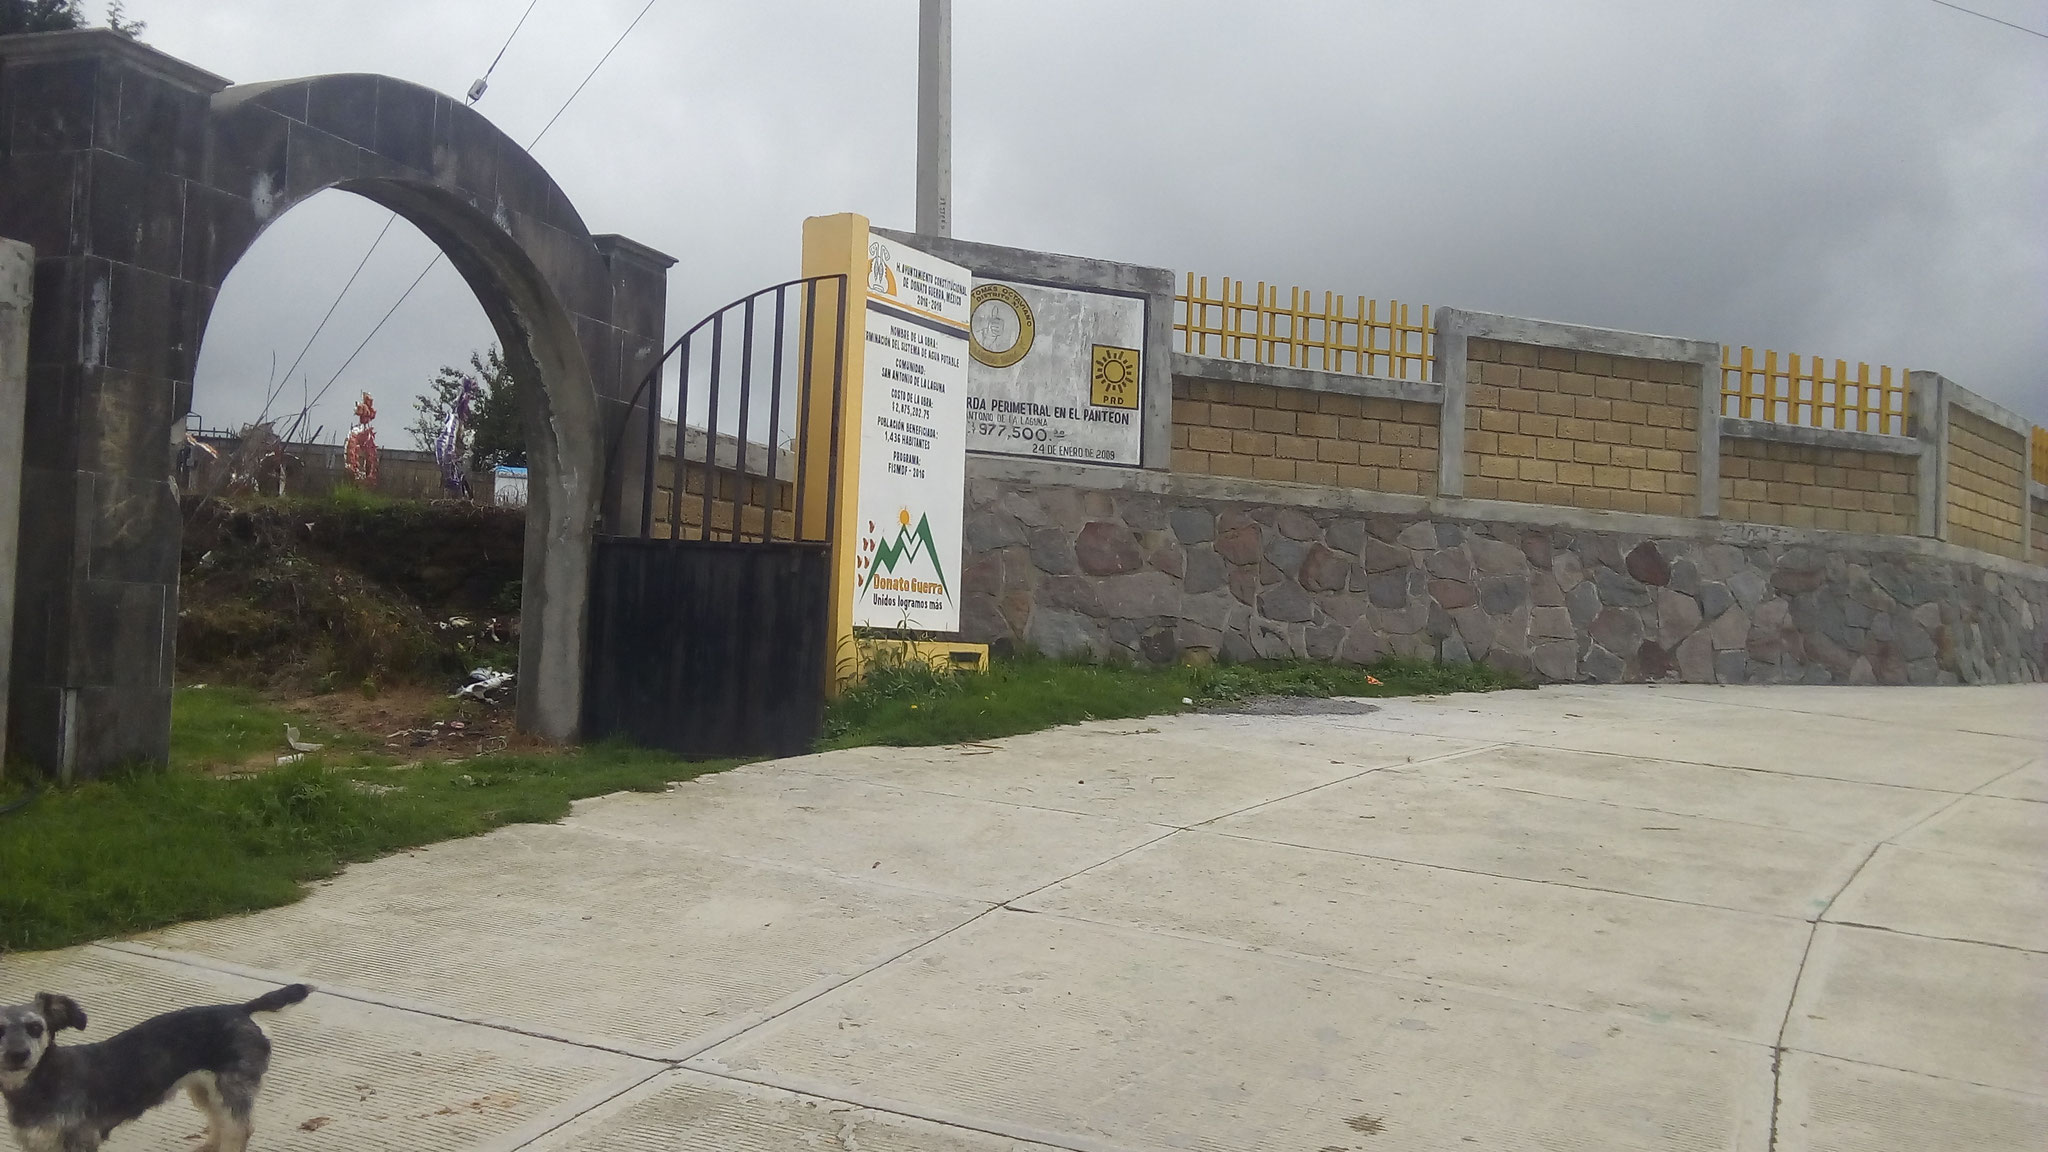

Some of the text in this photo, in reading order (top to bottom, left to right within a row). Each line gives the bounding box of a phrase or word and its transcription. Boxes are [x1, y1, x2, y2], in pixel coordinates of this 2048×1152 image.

[902, 263, 933, 284] AYUNTAMIENTO
[934, 275, 967, 296] CONSTITUCIONAL
[902, 276, 909, 289] DE
[910, 279, 928, 295] DONATO
[976, 292, 1009, 303] DISTRITO
[1002, 288, 1032, 327] OCTAVIANO
[890, 325, 910, 341] NOMBRE
[910, 331, 917, 343] DE
[917, 333, 924, 344] LA
[892, 338, 900, 351] DEL
[900, 341, 920, 356] SISTEMA
[921, 348, 928, 359] DE
[928, 350, 940, 361] AGUA
[940, 352, 960, 368] POTABLE
[895, 358, 926, 376] COMUNIDAD:
[881, 367, 946, 394] SAN ANTONIO DE LA LAGUNA
[891, 388, 906, 400] COSTO
[907, 391, 914, 403] DE
[914, 394, 920, 405] LA
[1103, 395, 1124, 405] PRD
[991, 399, 1051, 417] PERIMETRAL
[1054, 407, 1066, 419] EN
[1069, 407, 1080, 420] EL
[1083, 408, 1129, 425] PANTEON
[997, 413, 1006, 423] DE
[877, 416, 905, 431] POBLACIÓN
[884, 431, 930, 450] 1,436 HABITANTES
[893, 450, 921, 466] PROGRAMA:
[1032, 443, 1115, 460] 24 DE ENERO DE 2009
[913, 467, 925, 479] 2016
[873, 573, 943, 595] Donato Guerra
[873, 593, 943, 610] Unidos logramos más
